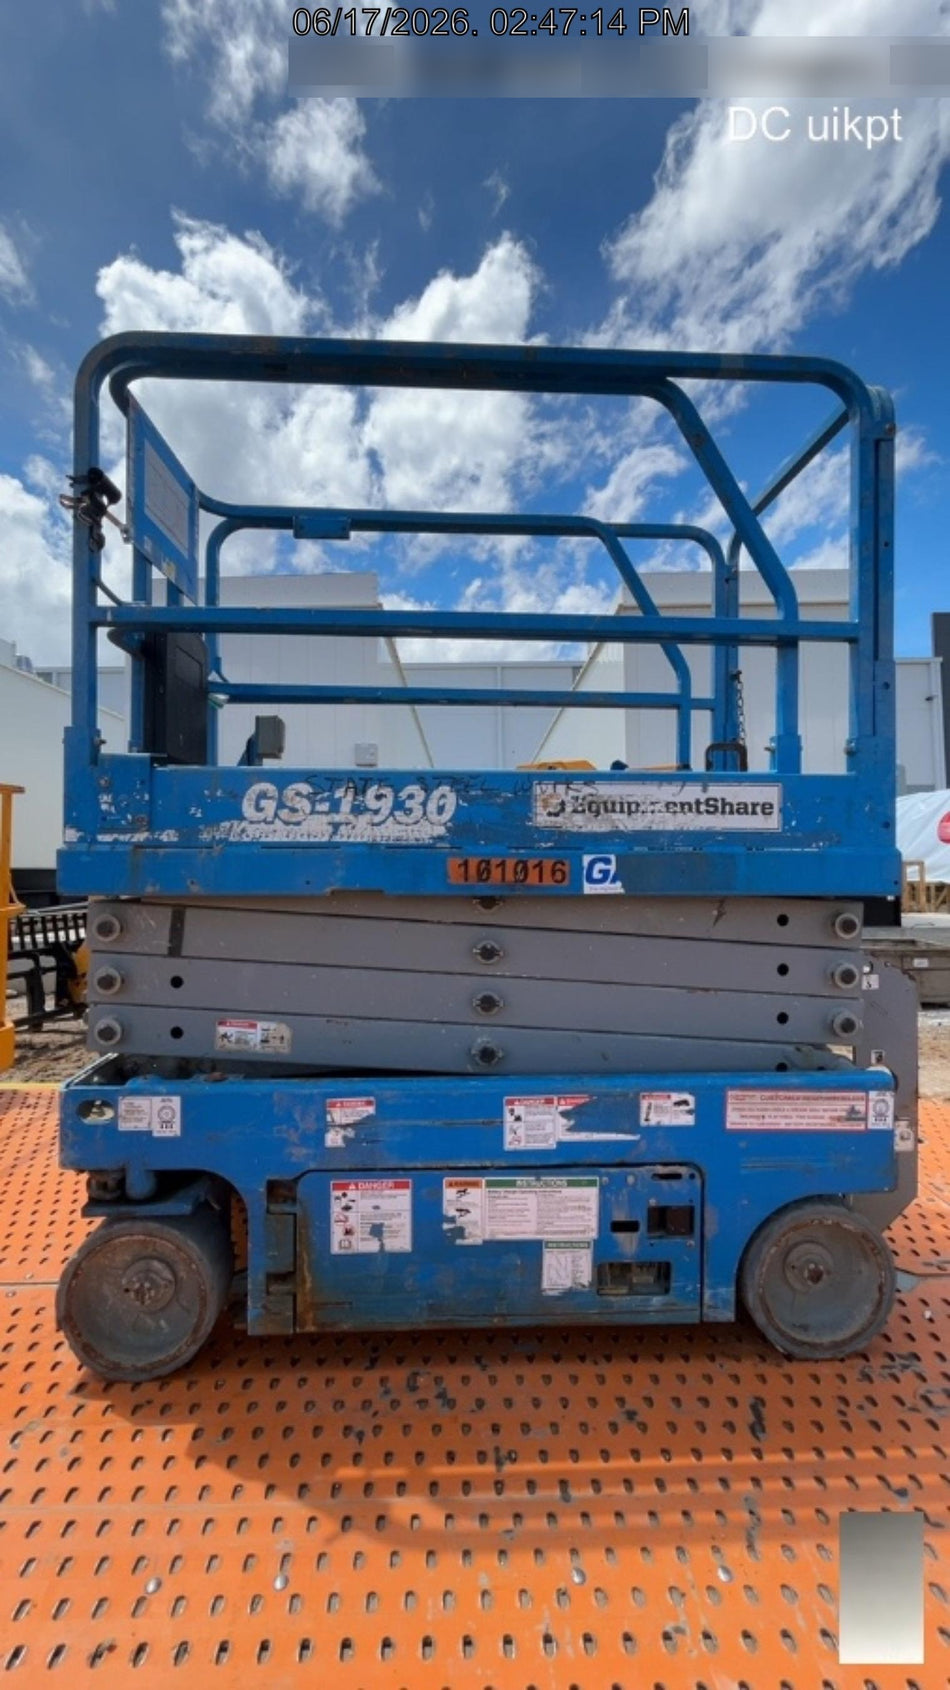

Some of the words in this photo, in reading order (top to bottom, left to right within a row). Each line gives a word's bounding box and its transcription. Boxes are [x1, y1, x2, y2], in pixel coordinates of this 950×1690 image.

[241, 782, 457, 826] GS-1930
[570, 796, 774, 818] EquipentShare
[457, 858, 567, 884] 101016
